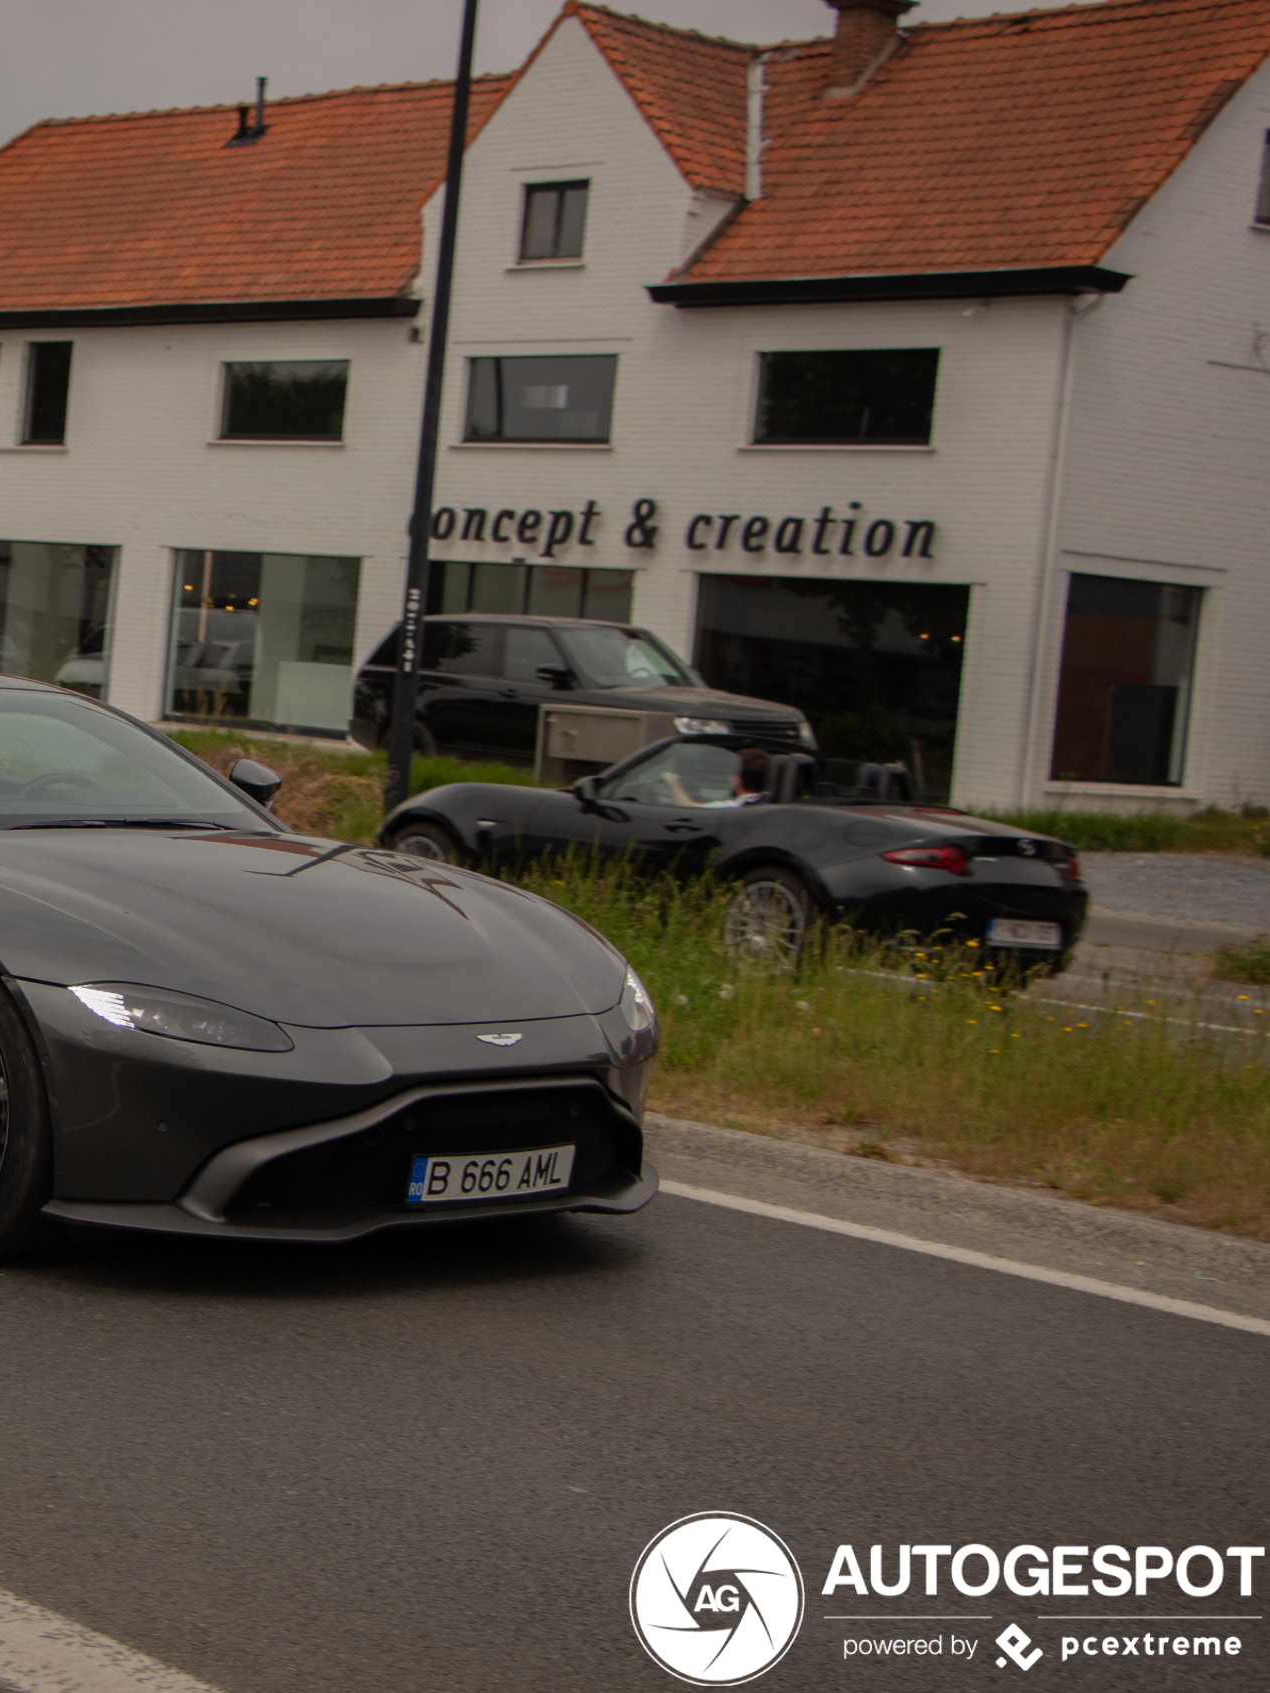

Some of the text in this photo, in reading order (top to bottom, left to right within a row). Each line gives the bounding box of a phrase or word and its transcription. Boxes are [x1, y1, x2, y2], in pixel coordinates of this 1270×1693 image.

[409, 498, 936, 558] oncept & creation
[408, 1182, 424, 1196] RO
[427, 1152, 562, 1195] B 666 AML
